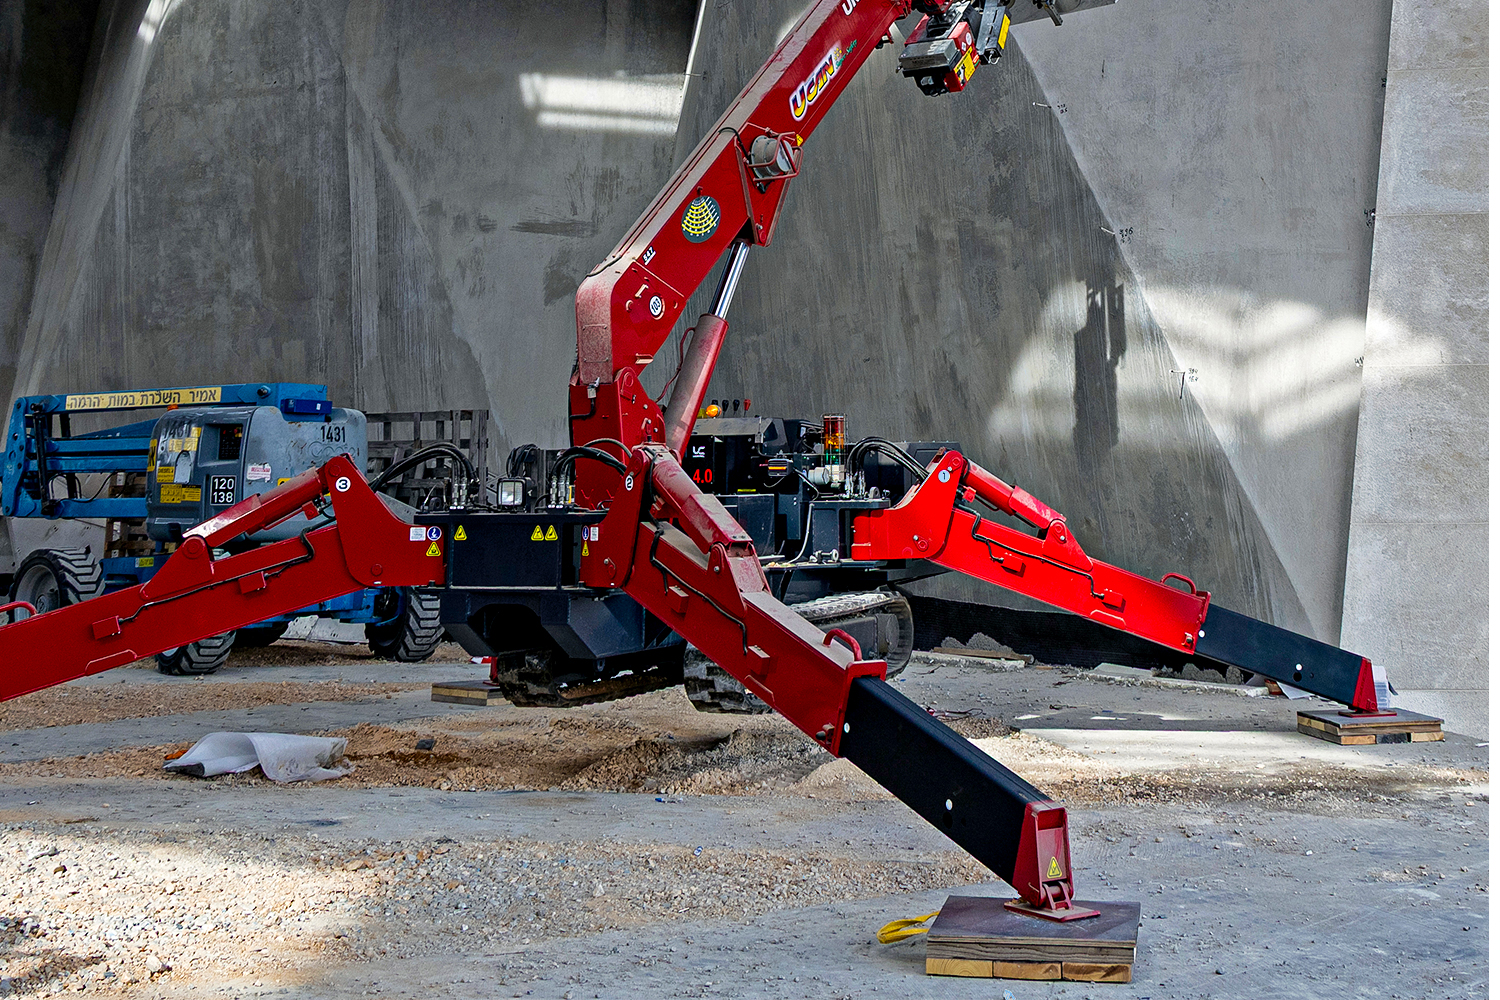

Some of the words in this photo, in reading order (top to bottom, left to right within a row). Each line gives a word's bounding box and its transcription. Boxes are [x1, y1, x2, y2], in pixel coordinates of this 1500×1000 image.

[70, 395, 100, 409] הרמה
[107, 394, 135, 408] במות
[189, 389, 216, 402] אמיר
[320, 426, 346, 442] 1431
[693, 469, 713, 483] 4.0
[213, 478, 234, 490] 120
[338, 479, 348, 489] 3
[626, 478, 631, 488] 2
[213, 491, 233, 503] 138
